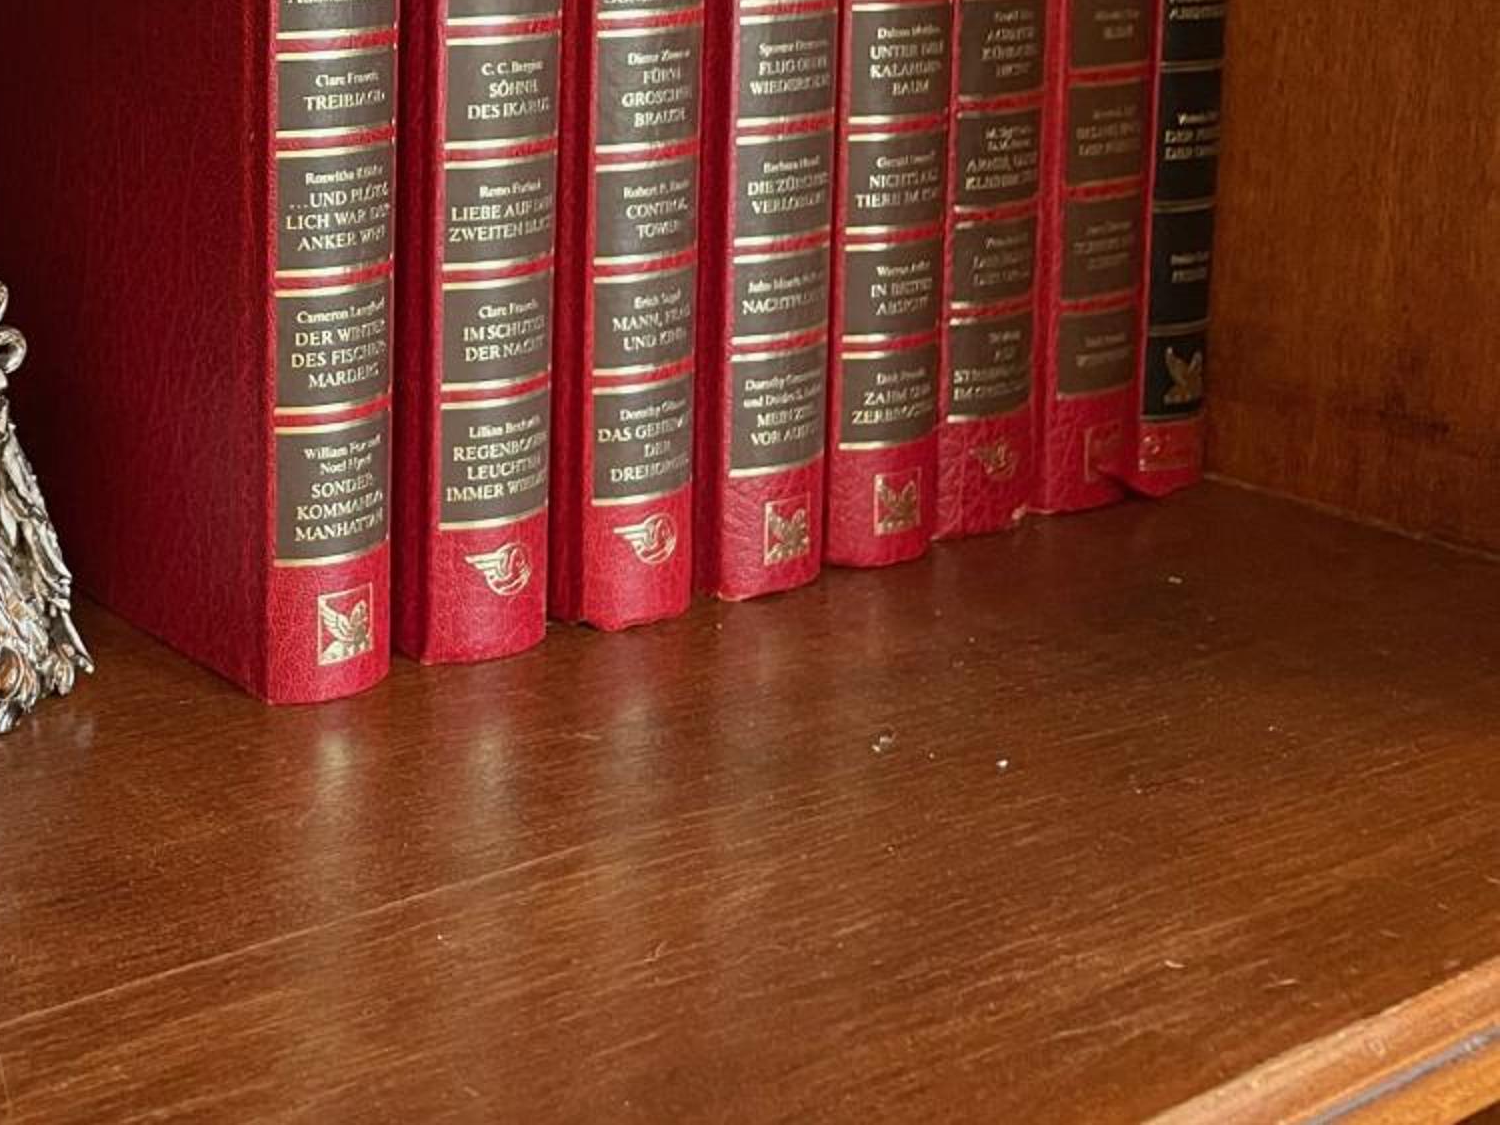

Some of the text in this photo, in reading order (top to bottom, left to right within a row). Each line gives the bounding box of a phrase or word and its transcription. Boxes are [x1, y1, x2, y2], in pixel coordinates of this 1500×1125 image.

[467, 104, 500, 120] DES
[286, 213, 329, 230] LICH
[451, 205, 501, 222] LIEBE
[448, 222, 523, 243] ZWEITEN
[297, 233, 357, 252] ANKER
[297, 309, 348, 324] Cameron
[295, 331, 333, 347] DER
[463, 325, 485, 342] IM
[623, 333, 657, 352] UND
[291, 352, 326, 368] DES
[465, 346, 501, 363] DER
[597, 427, 632, 443] DAS
[303, 446, 348, 460] William
[319, 458, 347, 475] Noel
[445, 483, 504, 503] IMMER
[295, 512, 383, 542] MANHATTAN
